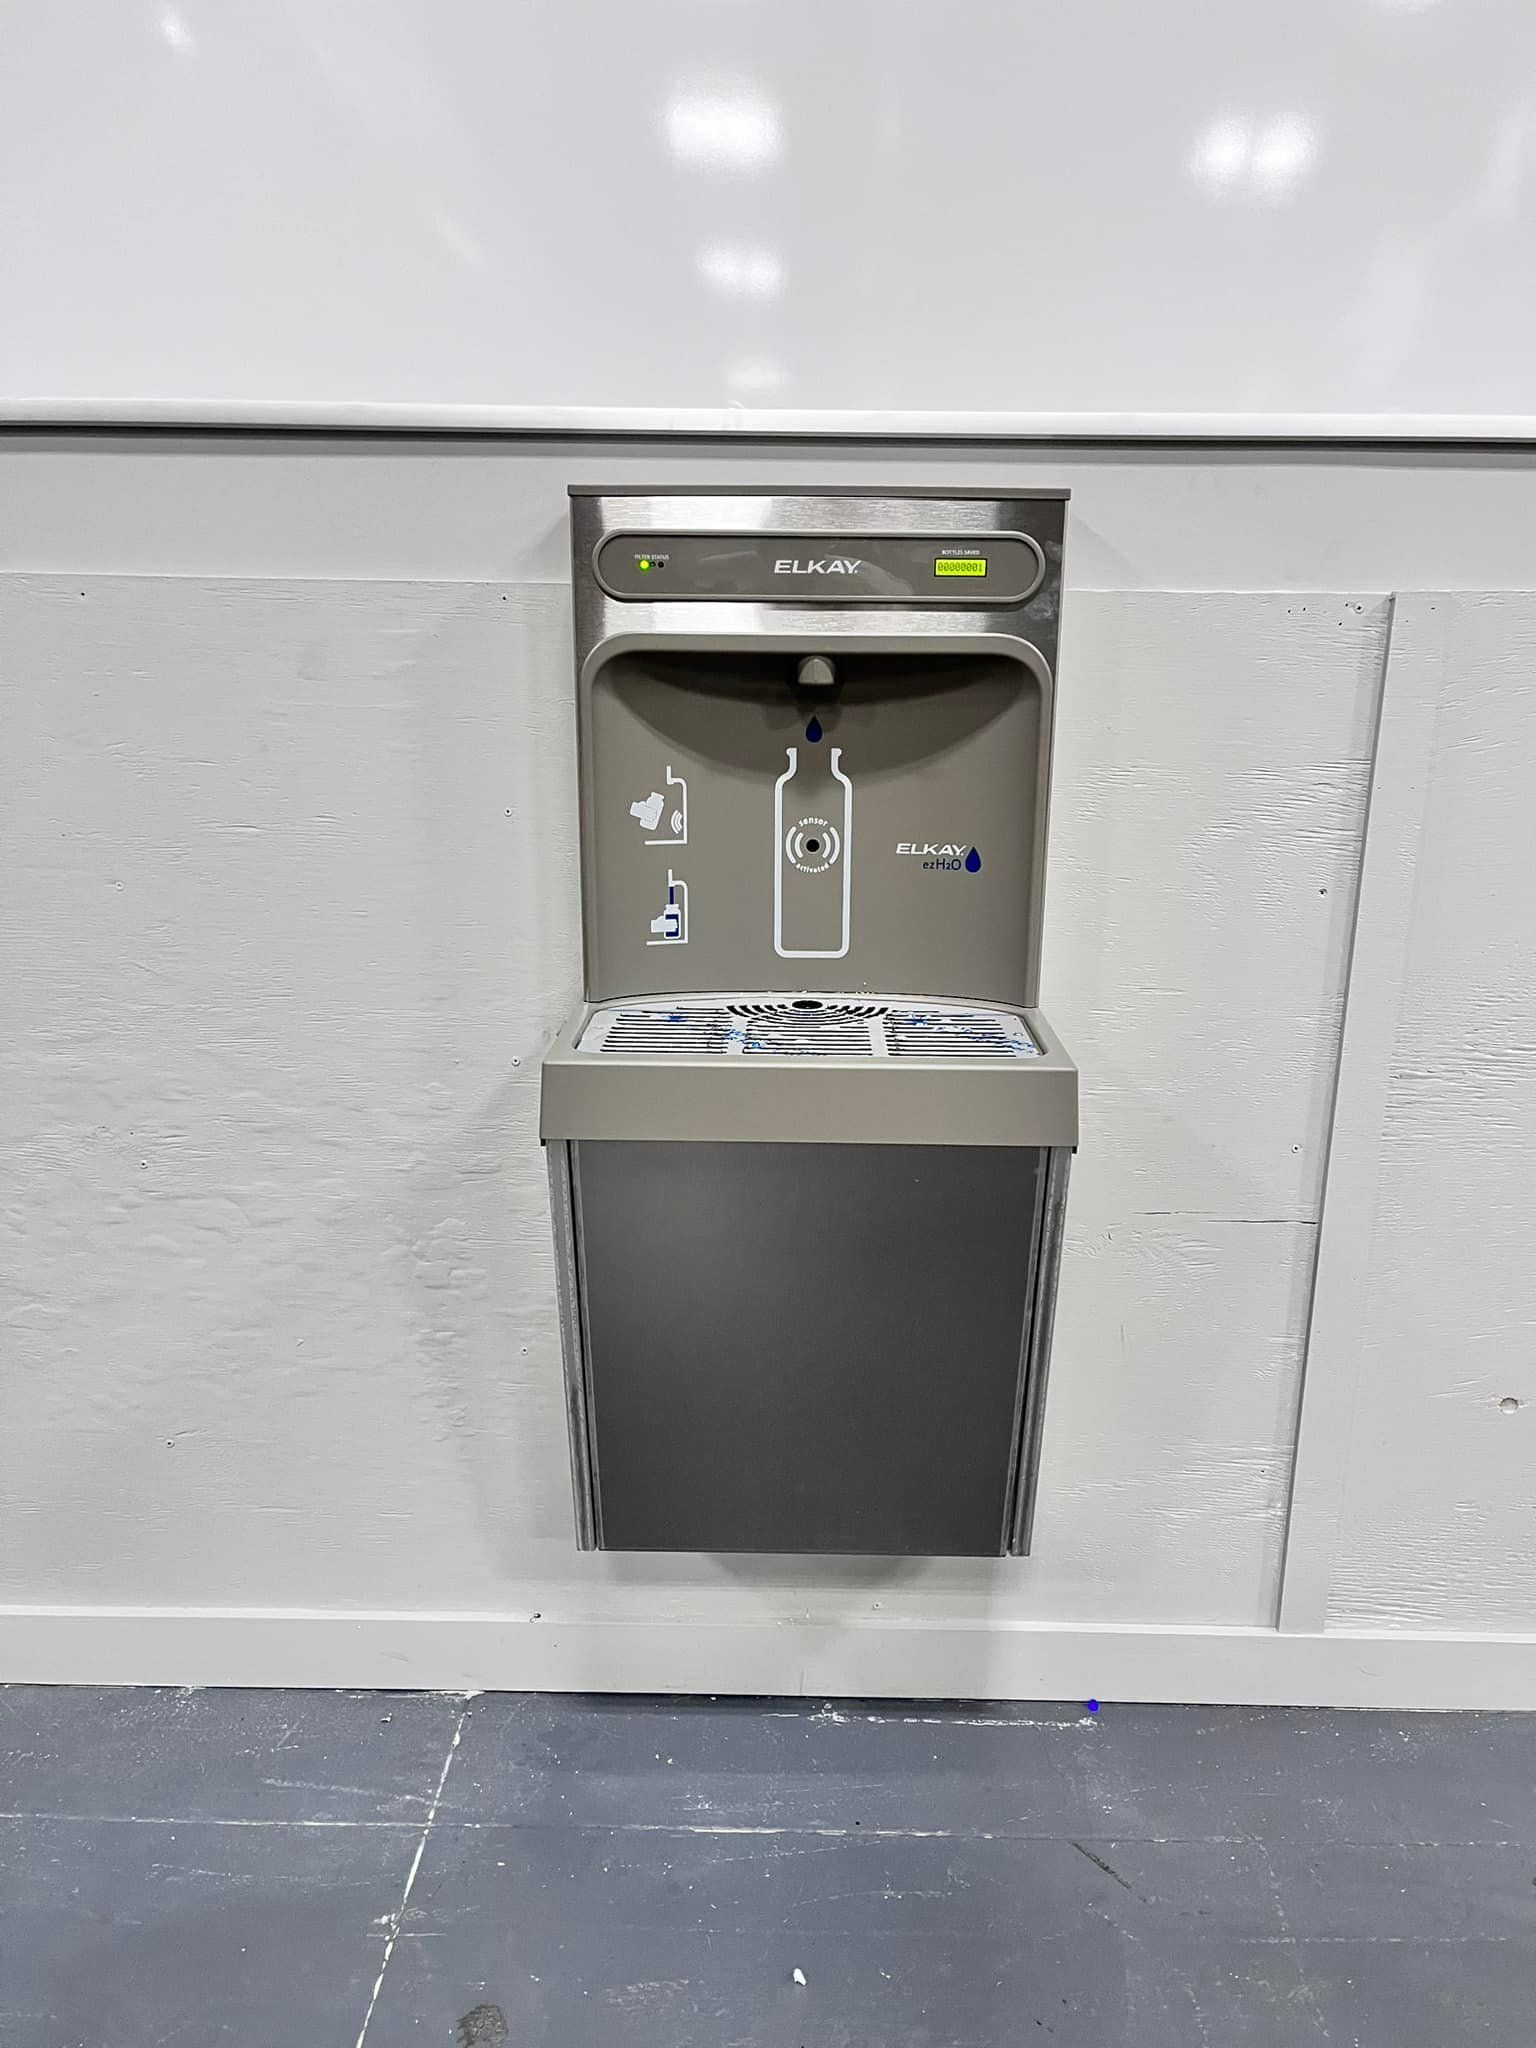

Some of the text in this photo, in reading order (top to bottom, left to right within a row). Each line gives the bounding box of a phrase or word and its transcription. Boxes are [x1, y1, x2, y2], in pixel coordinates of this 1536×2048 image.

[937, 562, 982, 572] 00000001
[798, 817, 828, 827] sensor
[796, 862, 830, 873] activated
